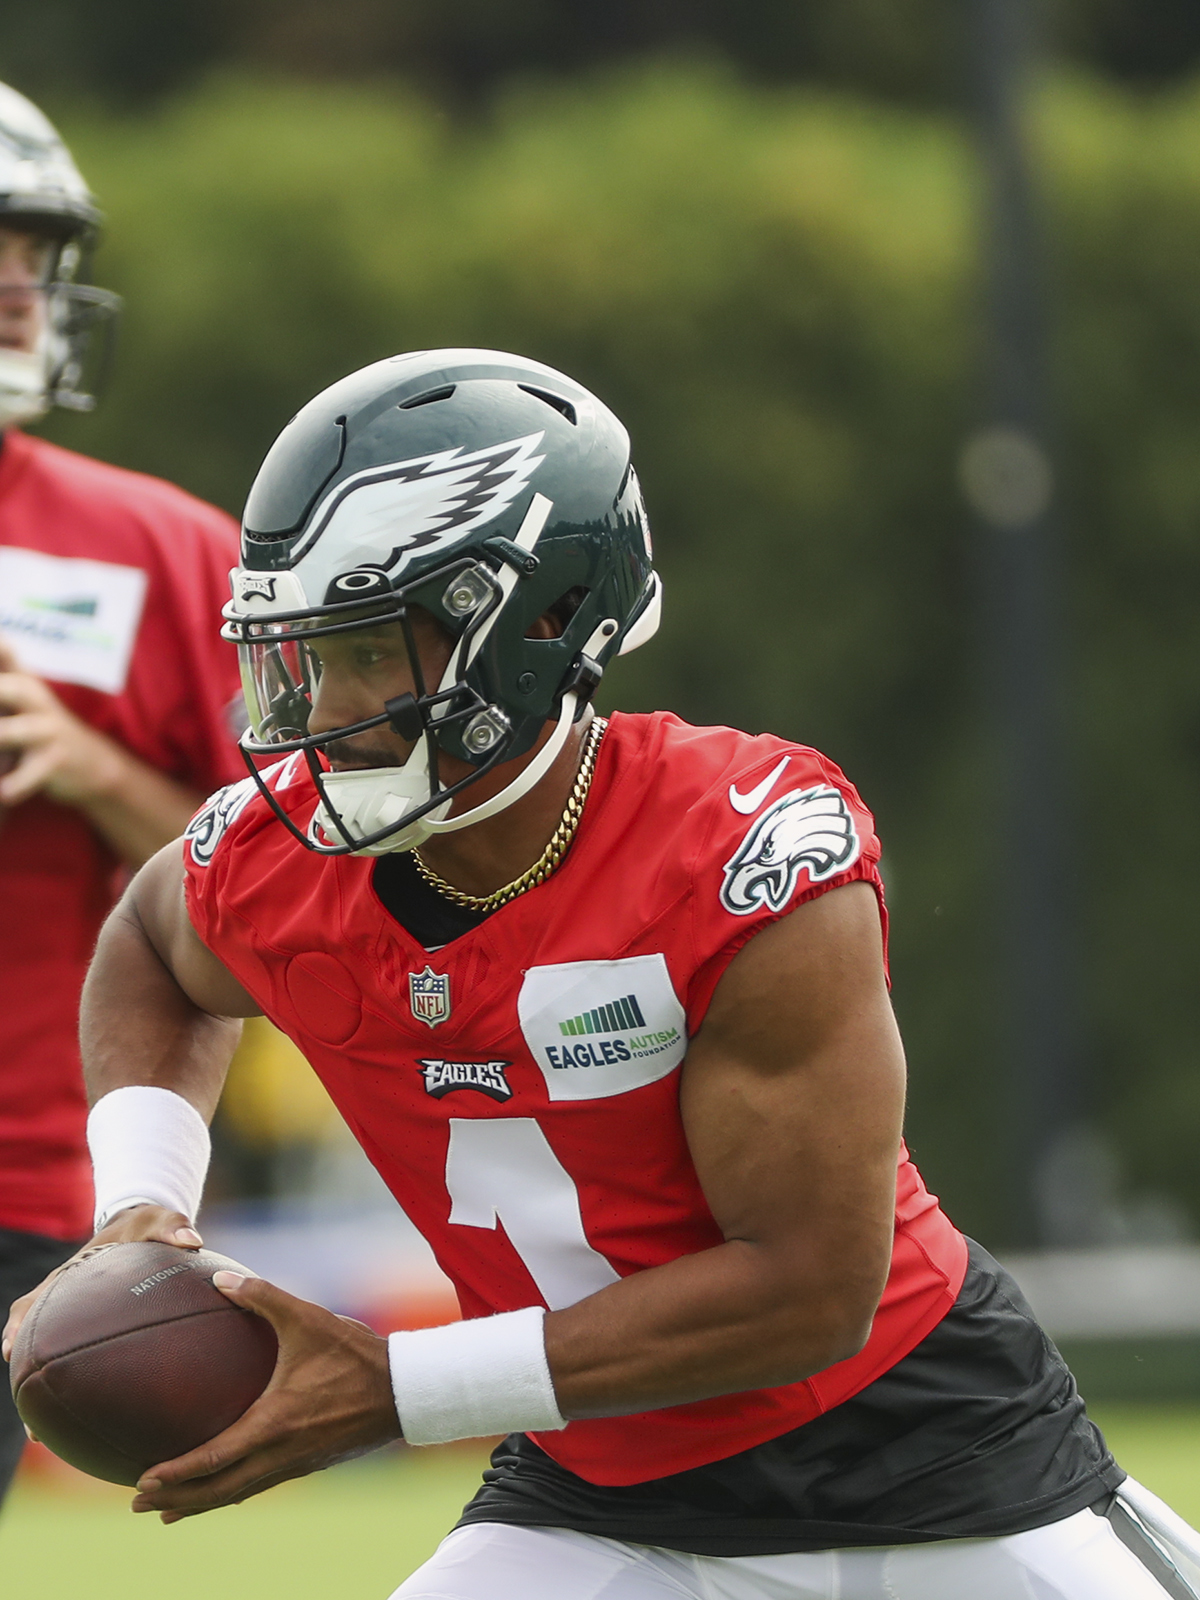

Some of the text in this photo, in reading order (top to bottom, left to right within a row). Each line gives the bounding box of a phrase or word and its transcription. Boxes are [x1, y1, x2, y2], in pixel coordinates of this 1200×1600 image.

[415, 994, 443, 1016] NFL
[545, 1026, 678, 1070] EAGLES AUTISM
[632, 1034, 682, 1059] FOUNDATION
[445, 1117, 622, 1312] 1
[130, 1263, 190, 1297] NATIONAL
